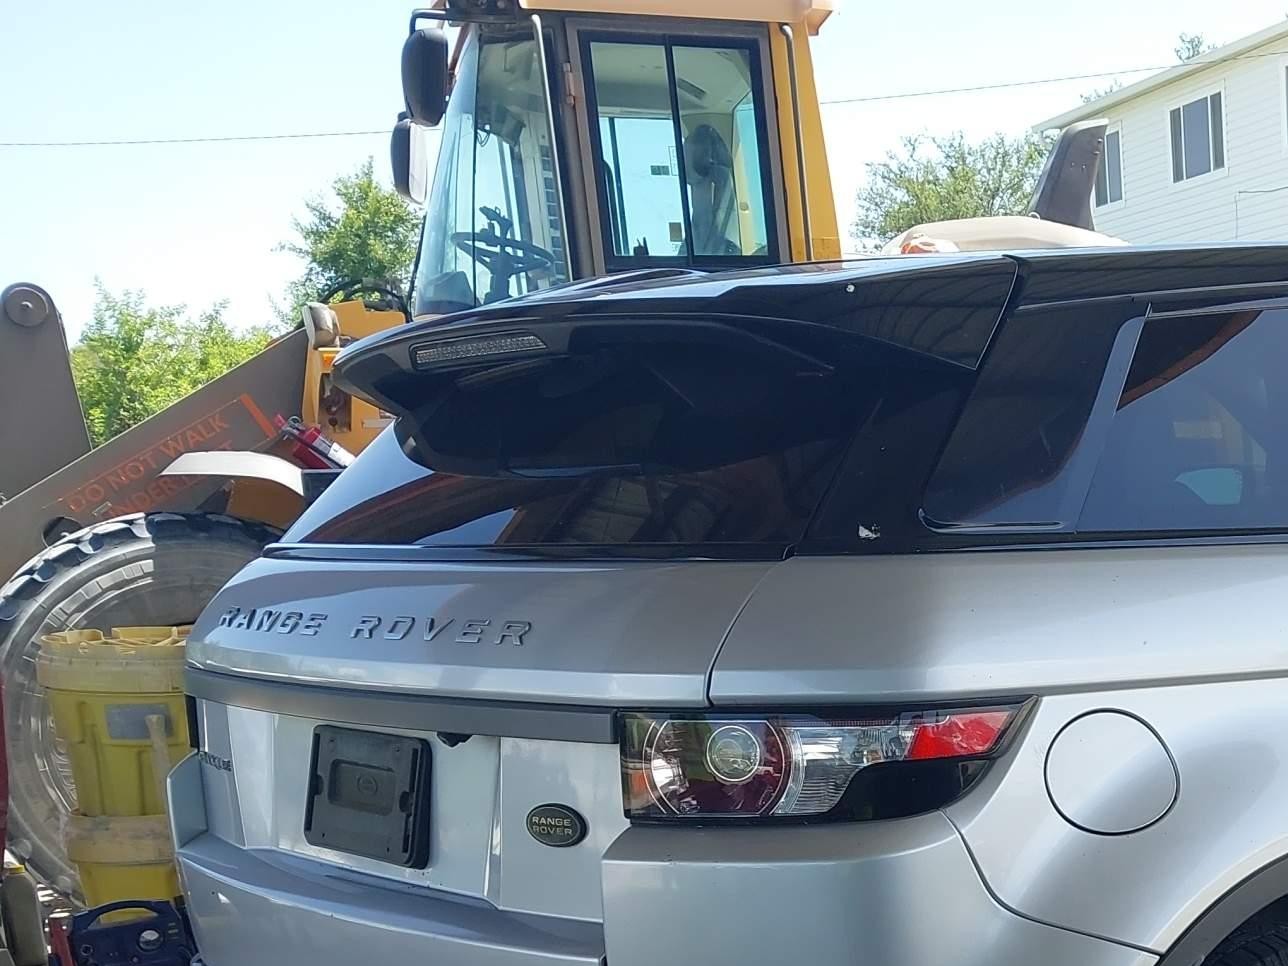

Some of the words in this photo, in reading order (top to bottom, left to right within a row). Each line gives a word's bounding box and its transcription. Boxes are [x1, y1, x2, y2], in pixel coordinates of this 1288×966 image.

[68, 483, 105, 513] DO
[108, 450, 157, 491] NOT
[160, 412, 231, 459] WALK
[218, 606, 328, 636] RANGE
[350, 615, 532, 646] ROVER
[532, 816, 572, 827] RANGE
[532, 825, 573, 837] ROVER
